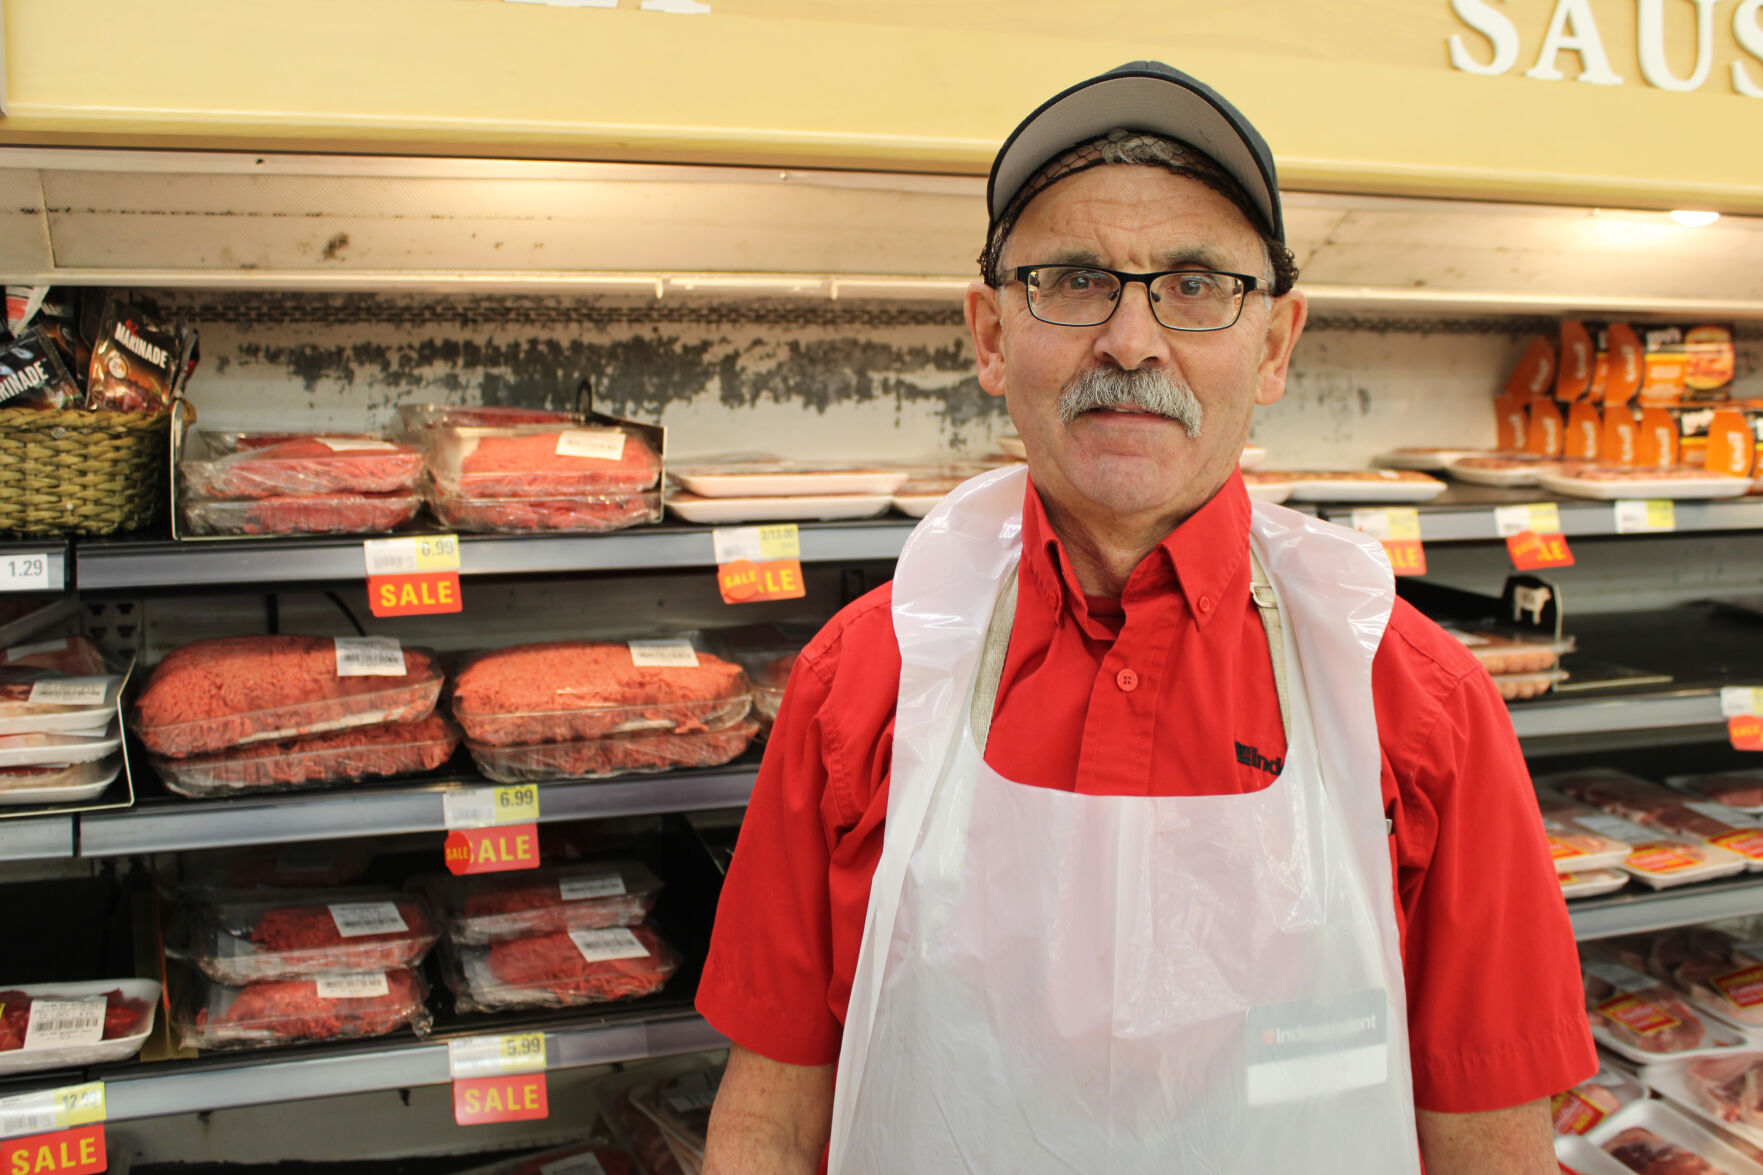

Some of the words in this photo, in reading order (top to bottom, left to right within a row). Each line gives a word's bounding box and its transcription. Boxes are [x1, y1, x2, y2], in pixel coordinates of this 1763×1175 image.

[115, 321, 168, 369] MARINADE
[8, 560, 43, 577] 1.29
[1384, 548, 1419, 568] LE
[724, 569, 757, 588] SALE
[757, 569, 796, 593] LE
[381, 580, 454, 608] SALE
[500, 789, 534, 808] 6.99
[446, 846, 468, 861] SALE
[469, 835, 531, 864] ALE
[506, 1037, 541, 1057] 5.99
[464, 1084, 540, 1114] SALE
[11, 1136, 97, 1175] SALE
